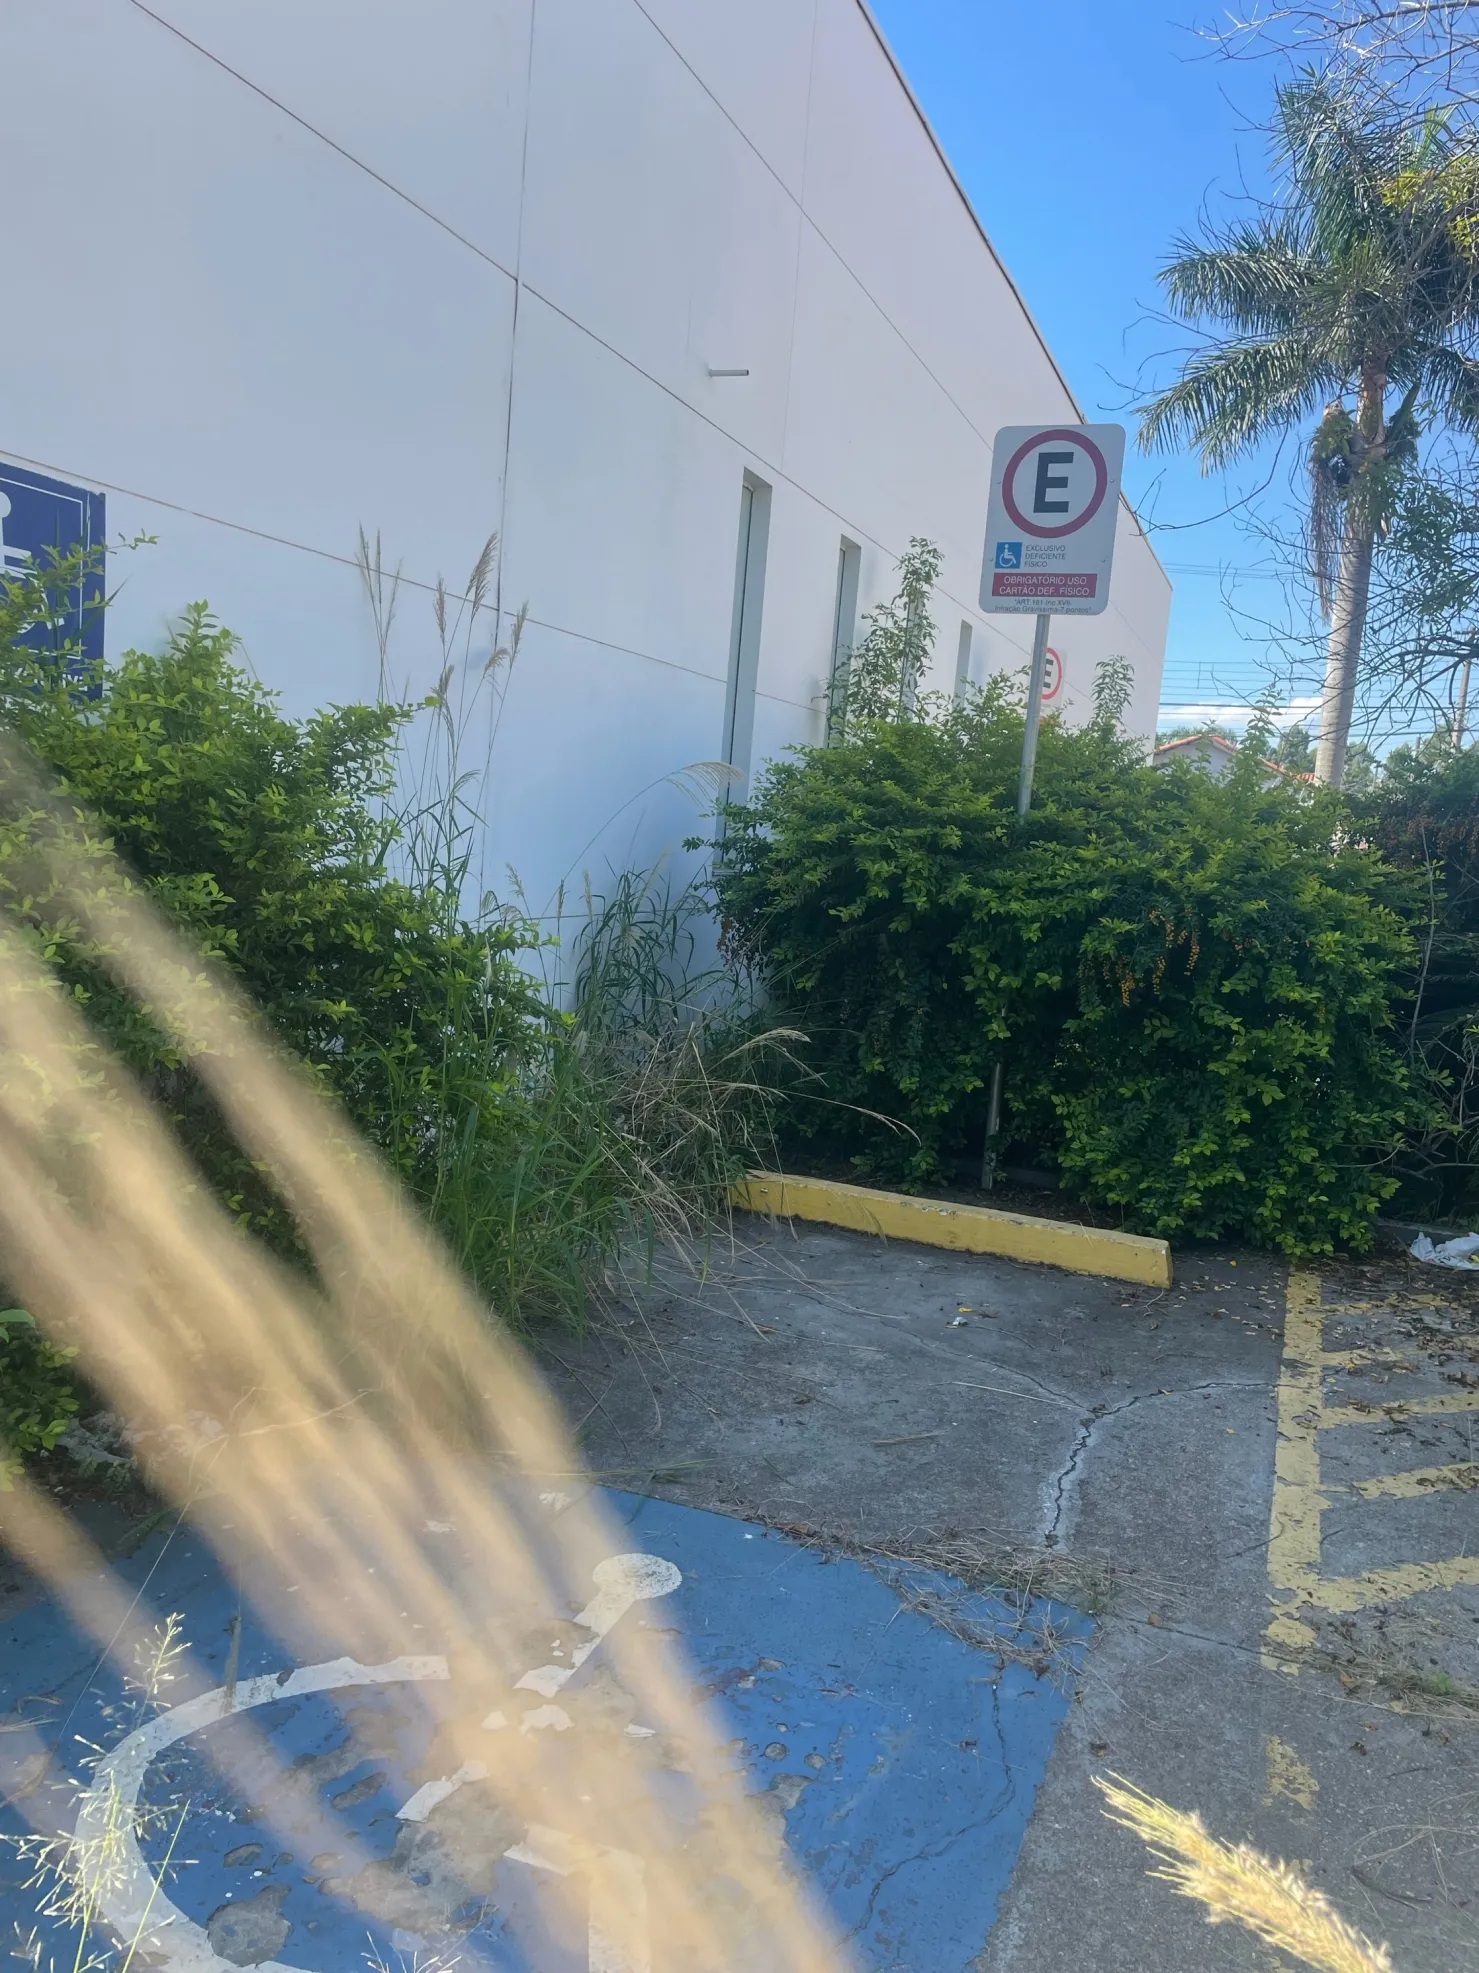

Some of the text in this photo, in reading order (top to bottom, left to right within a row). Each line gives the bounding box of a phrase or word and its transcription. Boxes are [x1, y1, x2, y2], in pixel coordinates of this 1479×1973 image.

[1033, 451, 1074, 514] E
[1025, 544, 1066, 553] EXCLUSIVO
[1024, 552, 1067, 561] DEFICIENTE
[1023, 560, 1048, 568] FÍSICO
[1003, 574, 1088, 585] OBRIGATÓRIO USO
[999, 585, 1090, 596] CARTÃO DEF. FÍSICO
